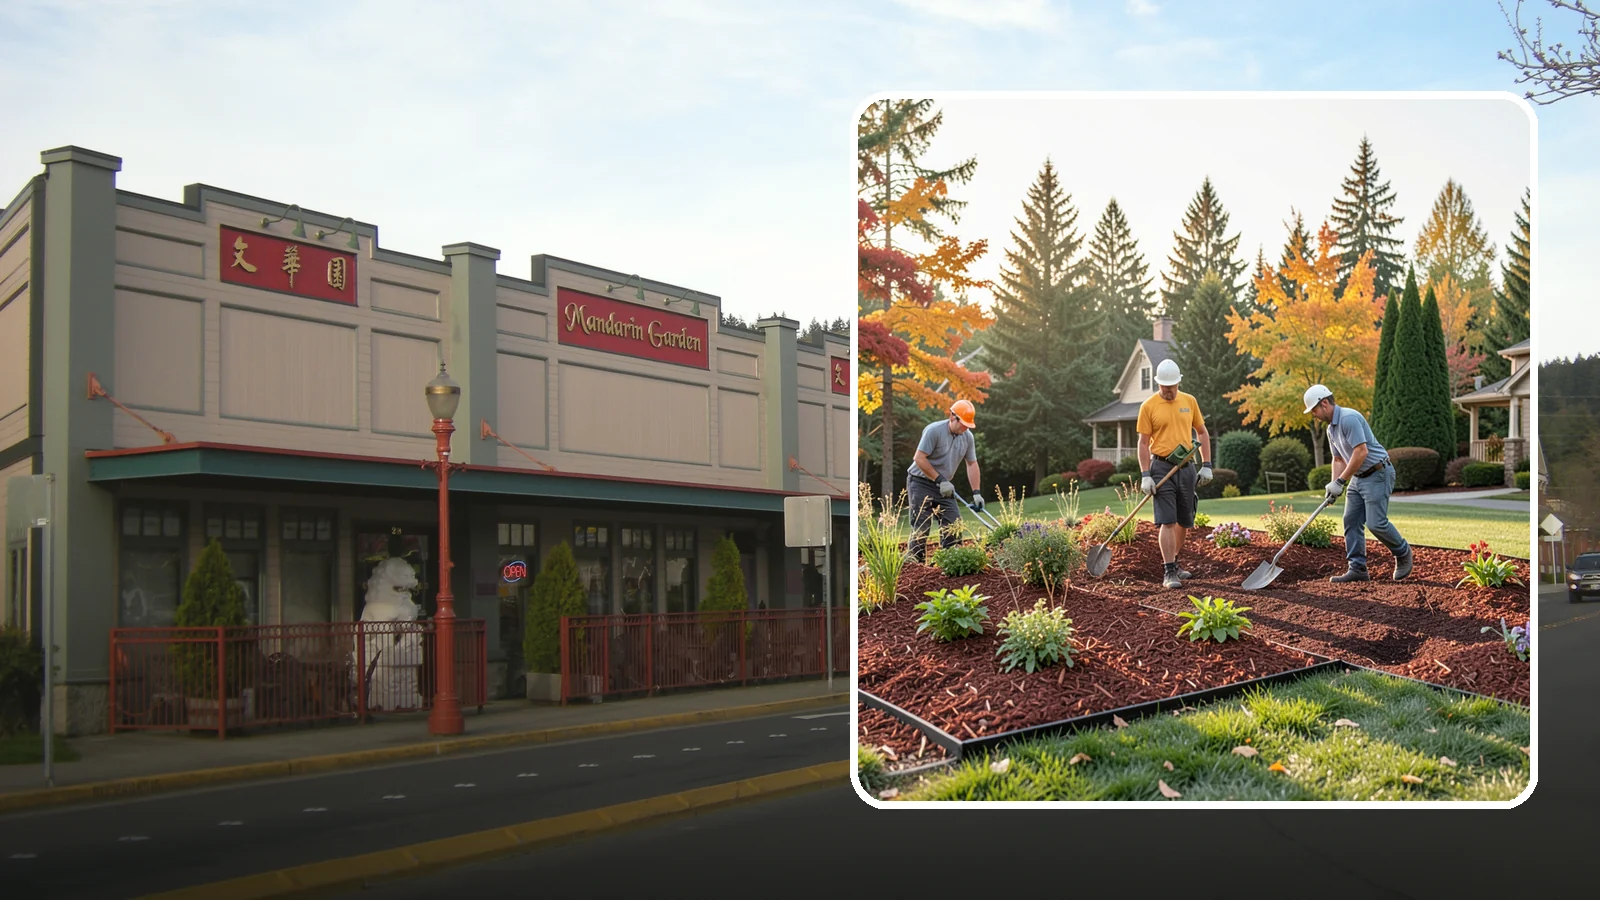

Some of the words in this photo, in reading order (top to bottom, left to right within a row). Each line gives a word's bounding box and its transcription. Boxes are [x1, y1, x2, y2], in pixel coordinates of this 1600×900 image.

[231, 235, 346, 290] 文華園
[564, 302, 644, 341] Mandarin
[648, 320, 701, 352] Garden
[503, 565, 527, 578] OPEN
